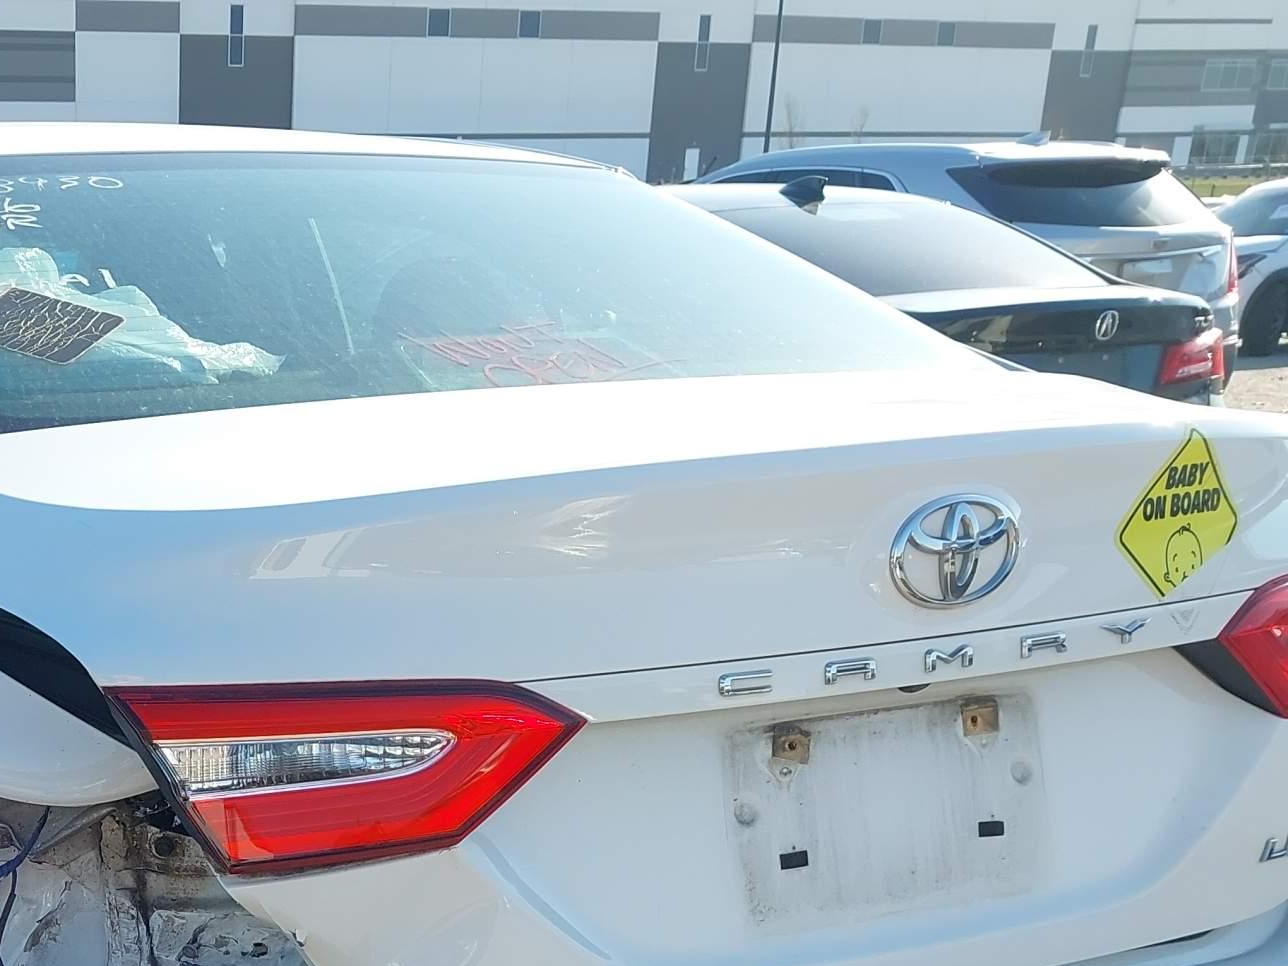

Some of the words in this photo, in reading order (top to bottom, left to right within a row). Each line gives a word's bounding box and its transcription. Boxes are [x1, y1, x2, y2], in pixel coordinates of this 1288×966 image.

[1165, 461, 1210, 490] BABY
[1142, 495, 1167, 521] ON
[1170, 487, 1221, 518] BOARD
[718, 616, 1153, 697] CAMRY
